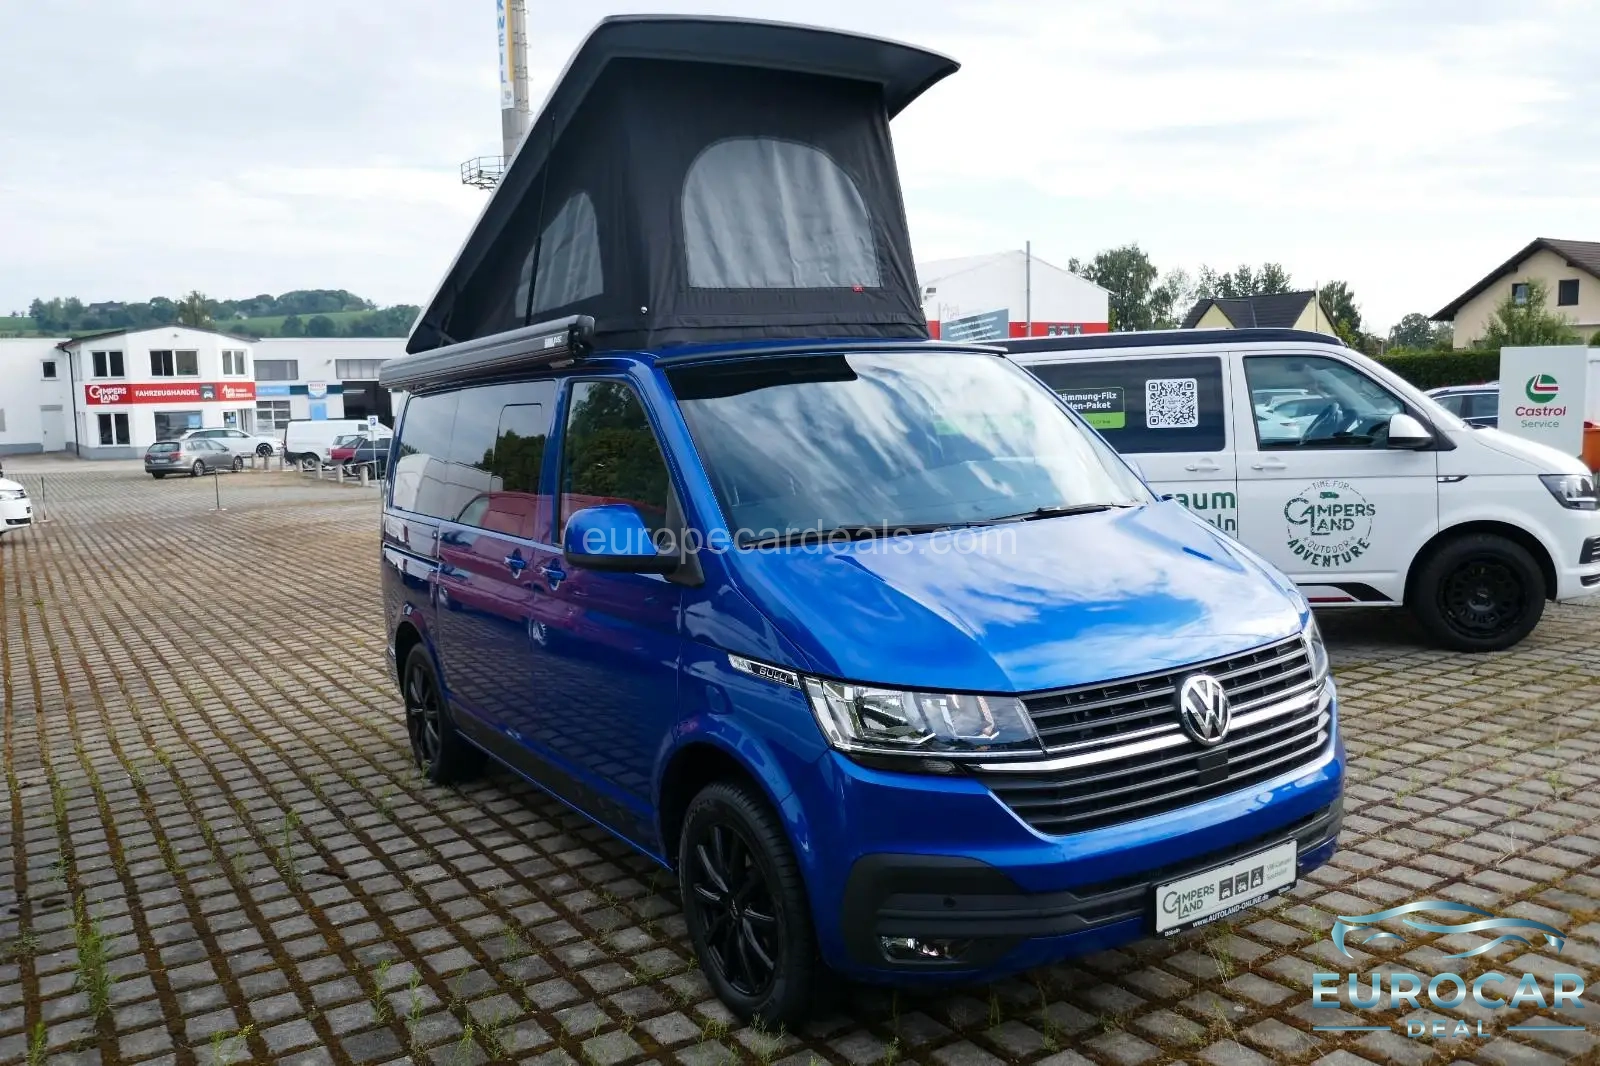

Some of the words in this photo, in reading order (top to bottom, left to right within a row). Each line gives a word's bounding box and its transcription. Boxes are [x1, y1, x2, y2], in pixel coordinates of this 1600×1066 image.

[135, 389, 200, 397] FAHRZEUGHANDEL
[1515, 406, 1567, 417] Castrol
[1520, 419, 1560, 428] Service
[1312, 480, 1331, 490] TIME
[1333, 480, 1350, 490] FOR
[1284, 497, 1376, 525] CAMPERS
[1287, 537, 1371, 567] ADVENTURE
[1307, 540, 1351, 554] OUTDOOR
[759, 666, 788, 682] BULLI
[1162, 883, 1215, 914] CAMPERS
[1192, 894, 1270, 928] www.AUTOLAND-ONLINE.de
